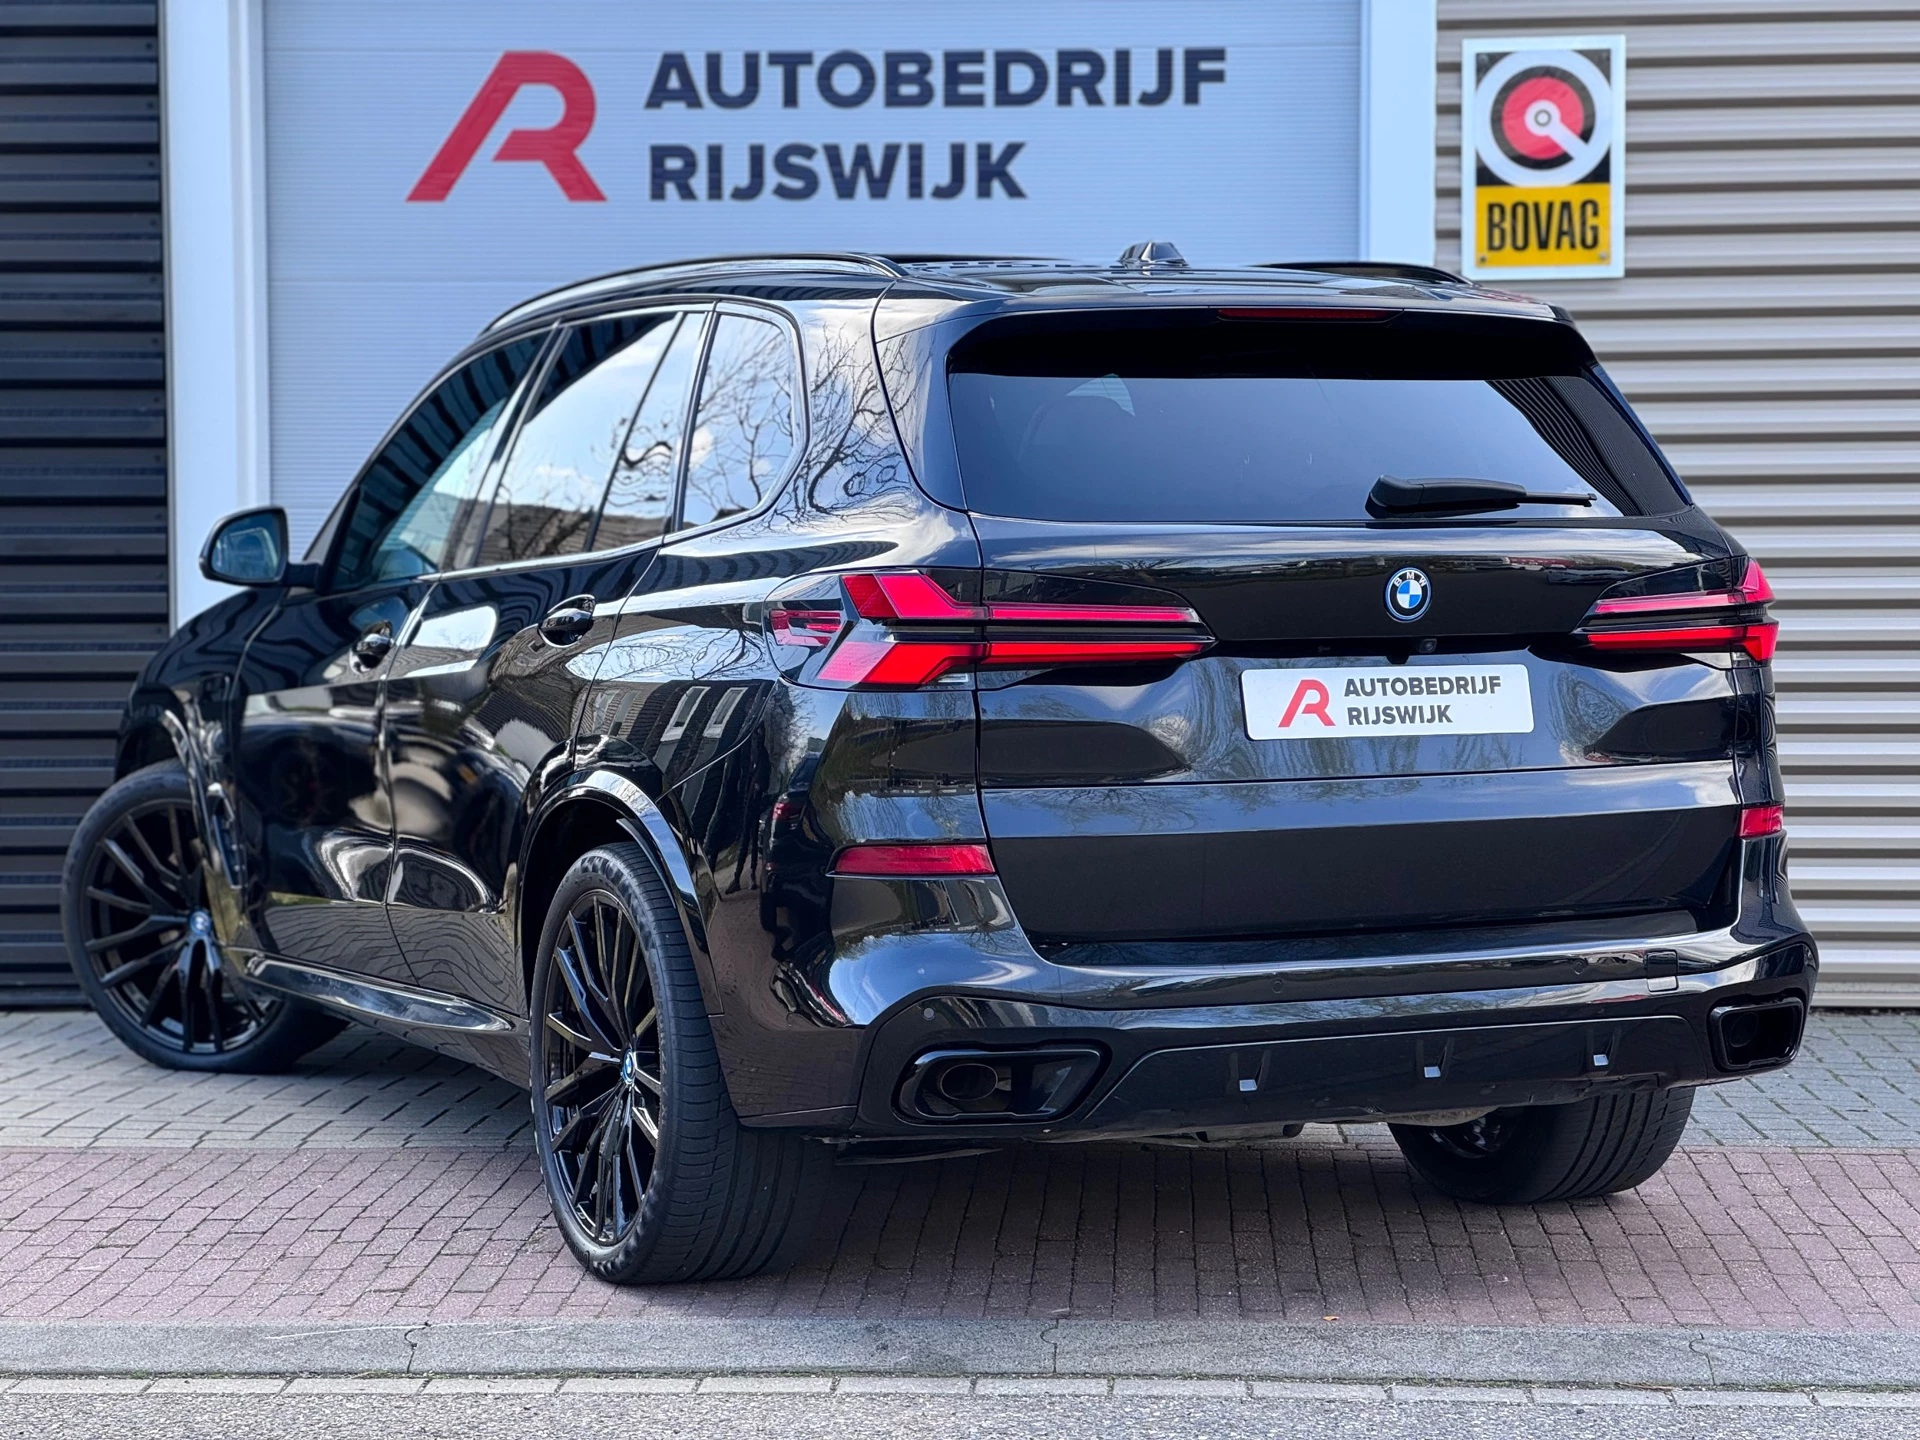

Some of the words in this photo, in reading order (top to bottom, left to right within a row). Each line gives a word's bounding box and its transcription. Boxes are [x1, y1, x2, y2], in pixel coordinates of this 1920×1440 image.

[644, 47, 1226, 109] AUTOBEDRIJF
[648, 141, 1028, 201] RIJSWIJK
[1487, 199, 1599, 251] BOVAG
[1393, 571, 1427, 587] BMW
[1344, 676, 1501, 697] AUTOBEDRIJF
[1347, 705, 1453, 725] RIJSWIJK
